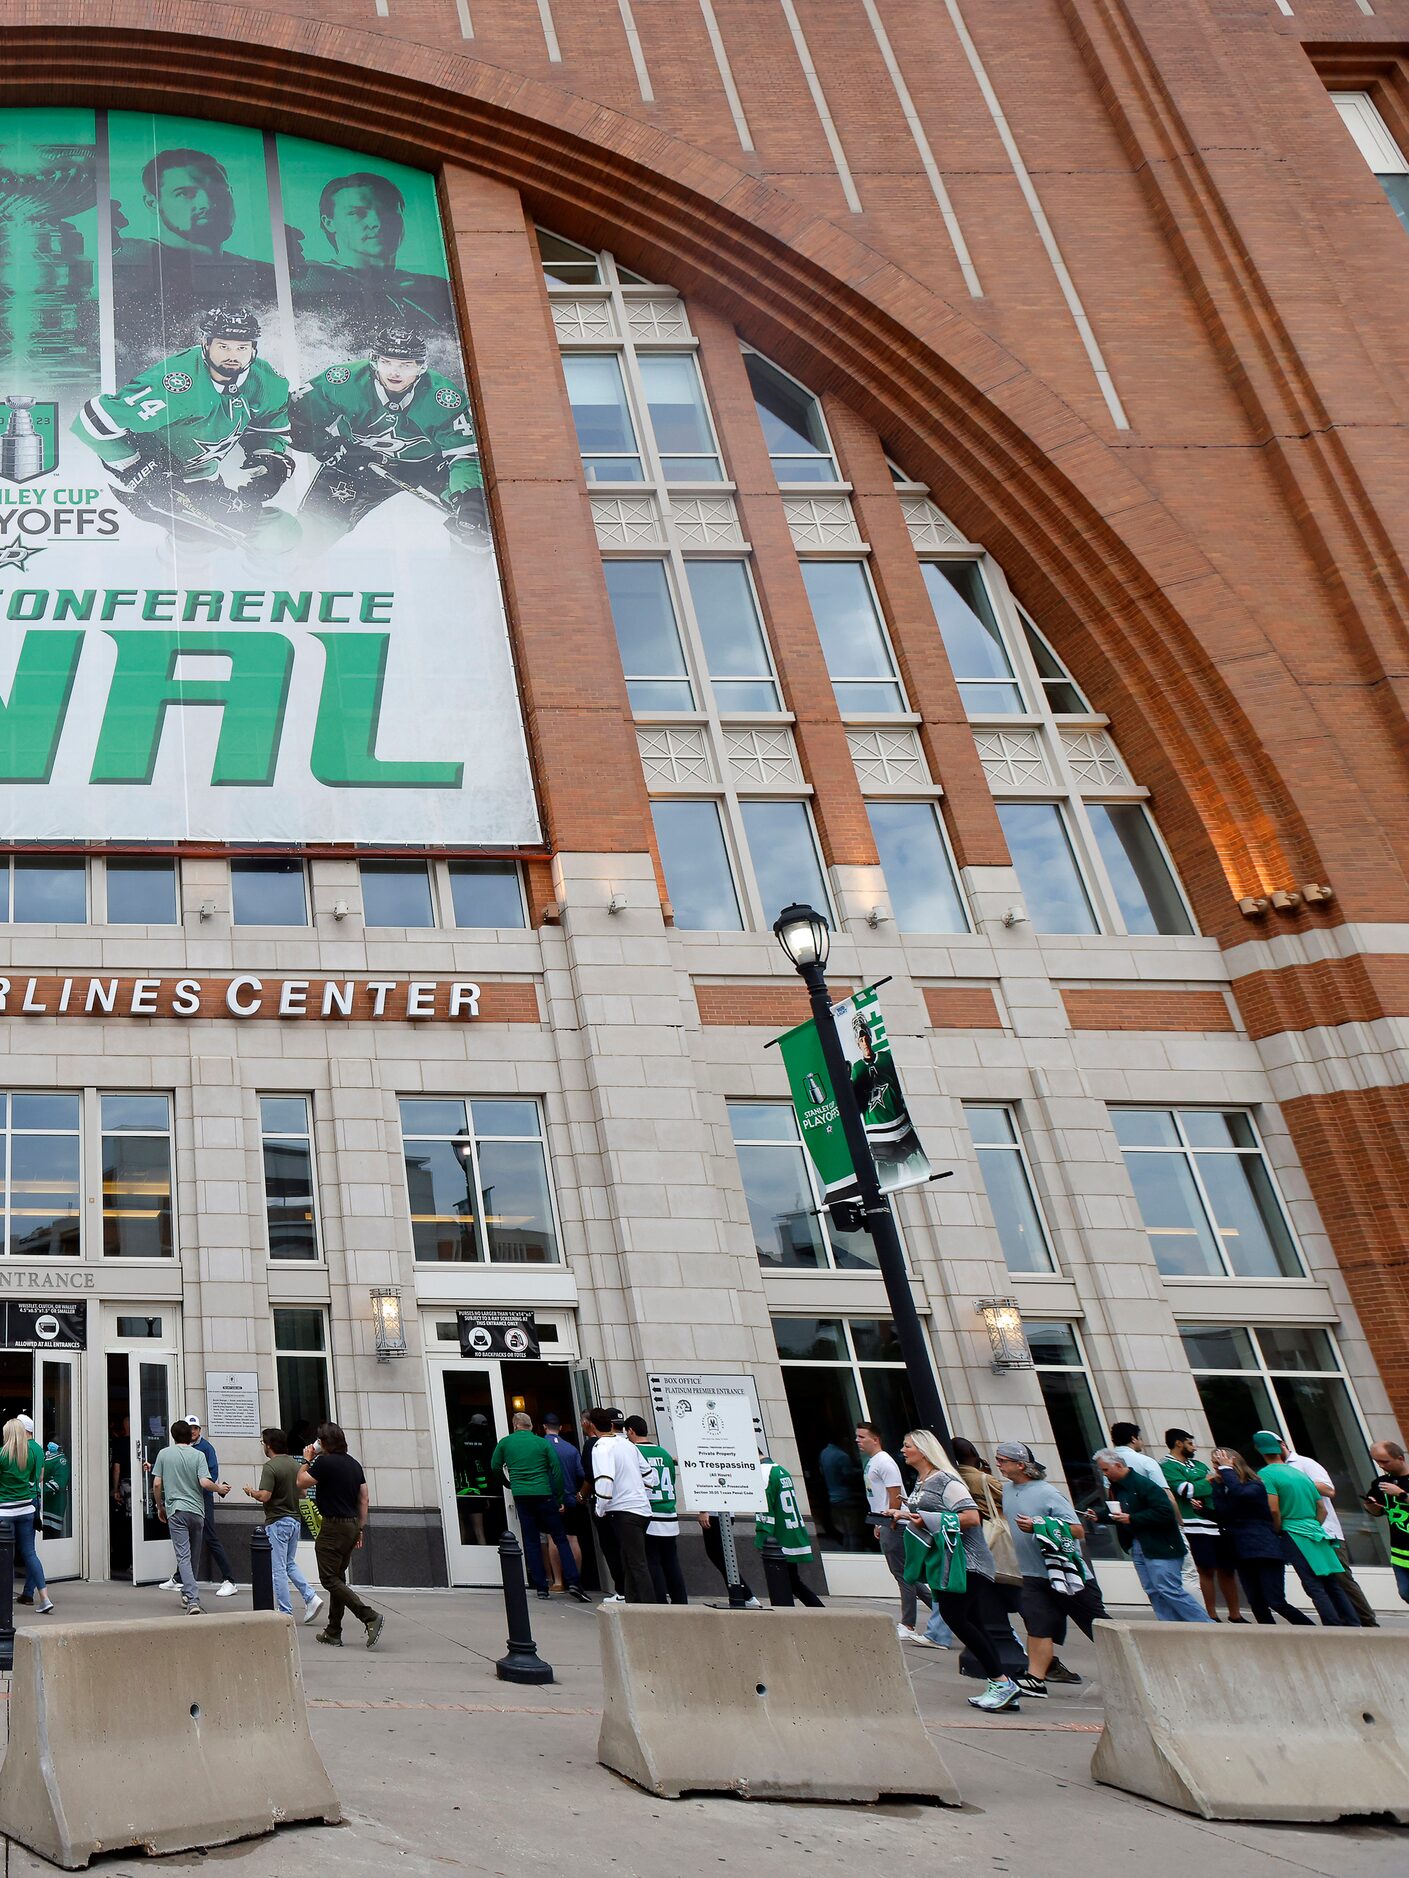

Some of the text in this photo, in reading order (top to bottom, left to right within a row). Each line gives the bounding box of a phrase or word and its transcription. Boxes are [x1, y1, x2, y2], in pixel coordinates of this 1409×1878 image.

[124, 387, 167, 421] 14
[36, 417, 51, 425] 23
[53, 488, 100, 505] CUP
[225, 975, 482, 1019] CENTER
[803, 1106, 840, 1130] PLAYOFFS
[804, 1104, 830, 1119] STANLEY
[684, 1460, 756, 1471] No Trespassing
[645, 1466, 676, 1500] 24
[779, 1489, 805, 1529] 91
